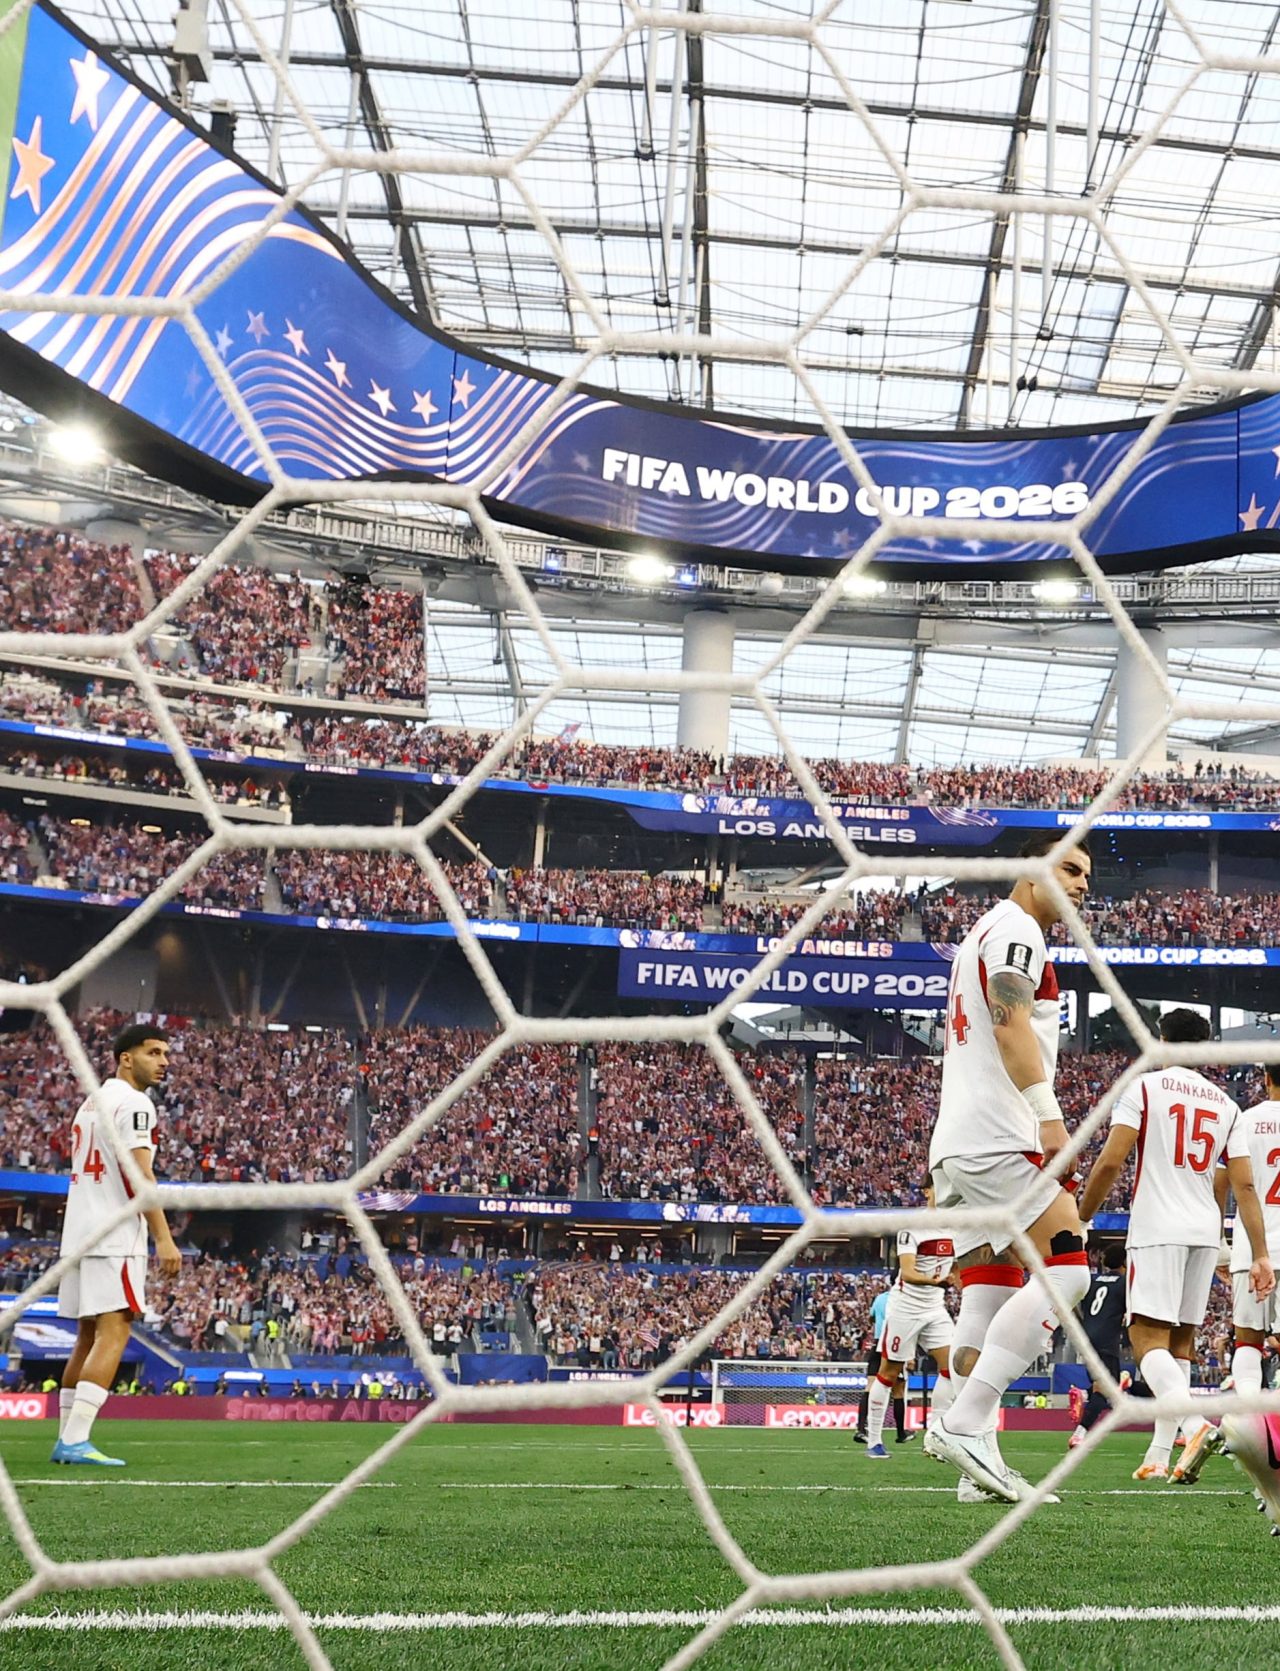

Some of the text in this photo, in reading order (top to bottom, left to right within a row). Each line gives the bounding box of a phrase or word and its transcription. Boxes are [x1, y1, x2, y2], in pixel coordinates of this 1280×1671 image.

[602, 448, 1090, 518] FIFA WORLD CUP 2026
[845, 806, 910, 820] ANGELES
[1136, 814, 1163, 827] CUP
[718, 819, 777, 836] LOS
[801, 939, 893, 957] ANGELES
[1048, 947, 1268, 964] FIFA WORLD CUP 2026
[637, 962, 699, 988] FIFA
[813, 971, 870, 995] CUP
[874, 974, 951, 997] 202
[1168, 1102, 1221, 1175] 15
[479, 1200, 572, 1215] LOS ANGELES
[1090, 1285, 1108, 1316] 8
[891, 1335, 901, 1353] 8
[225, 1399, 335, 1421] Smarter
[340, 1400, 370, 1421] AI
[378, 1399, 419, 1422] for
[769, 1408, 860, 1427] Lenovo
